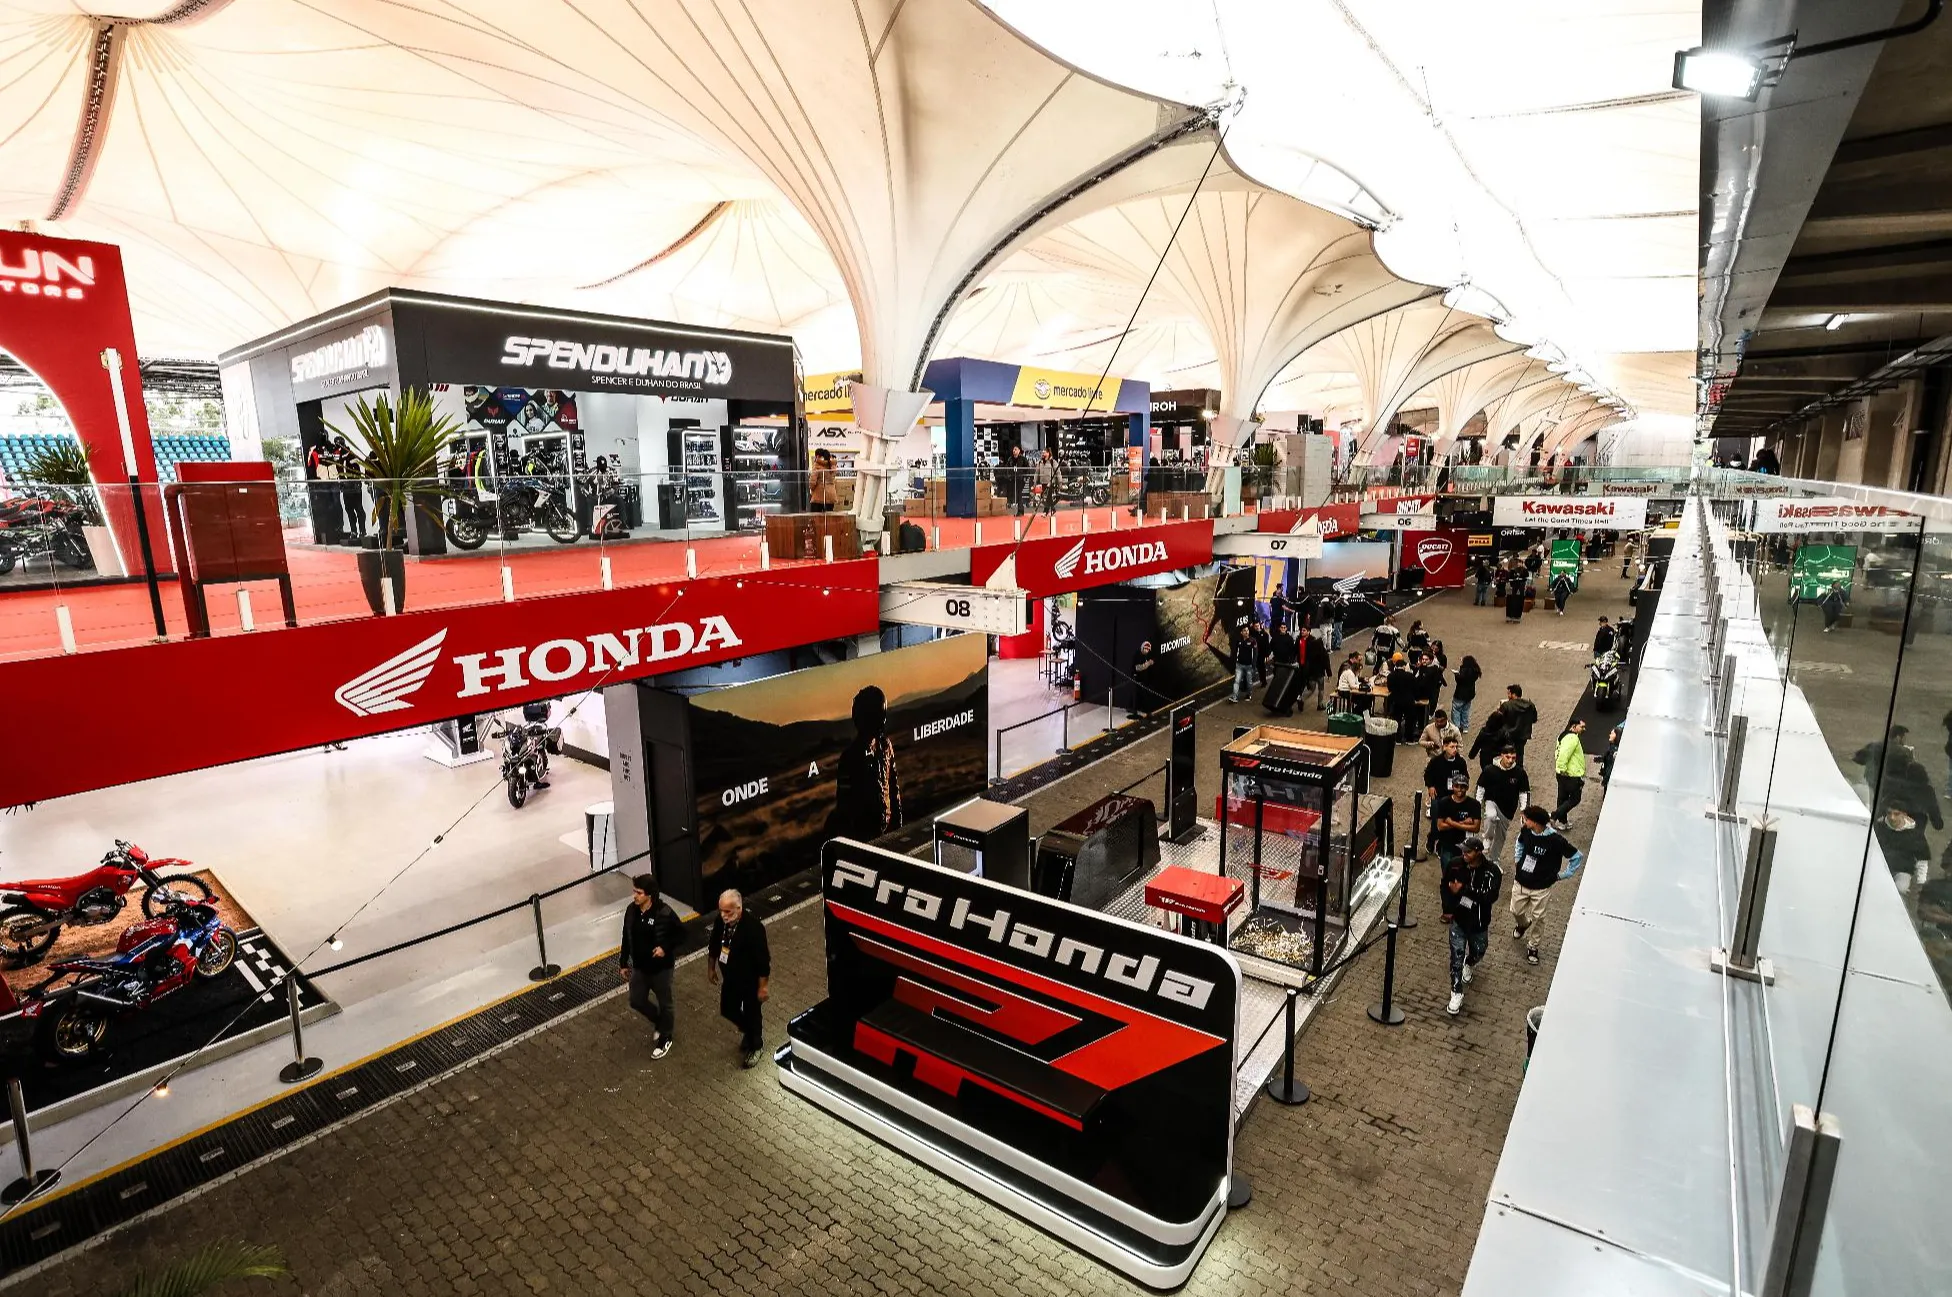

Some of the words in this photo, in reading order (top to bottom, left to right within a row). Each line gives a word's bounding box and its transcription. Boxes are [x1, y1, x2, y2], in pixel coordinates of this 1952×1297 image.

[0, 248, 95, 285] UN
[0, 280, 84, 299] TORS
[501, 336, 704, 378] SPENDUHAN
[591, 375, 628, 386] SPENCER
[628, 377, 634, 386] E
[635, 378, 665, 388] DUHAN
[666, 379, 679, 389] DO
[679, 380, 703, 390] BRASIL
[1053, 385, 1087, 398] mercado
[1150, 400, 1177, 412] IROH
[1522, 500, 1615, 516] Kawasaki
[1397, 517, 1412, 526] 06
[1270, 539, 1288, 551] 07
[1421, 543, 1449, 551] DUCATI
[1084, 541, 1168, 575] HONDA
[945, 598, 971, 617] 08
[1160, 636, 1191, 655] ENCONTRA
[453, 615, 743, 698] HONDA
[721, 776, 769, 807] ONDE
[807, 760, 820, 778] A
[913, 708, 975, 742] LIBERDADE
